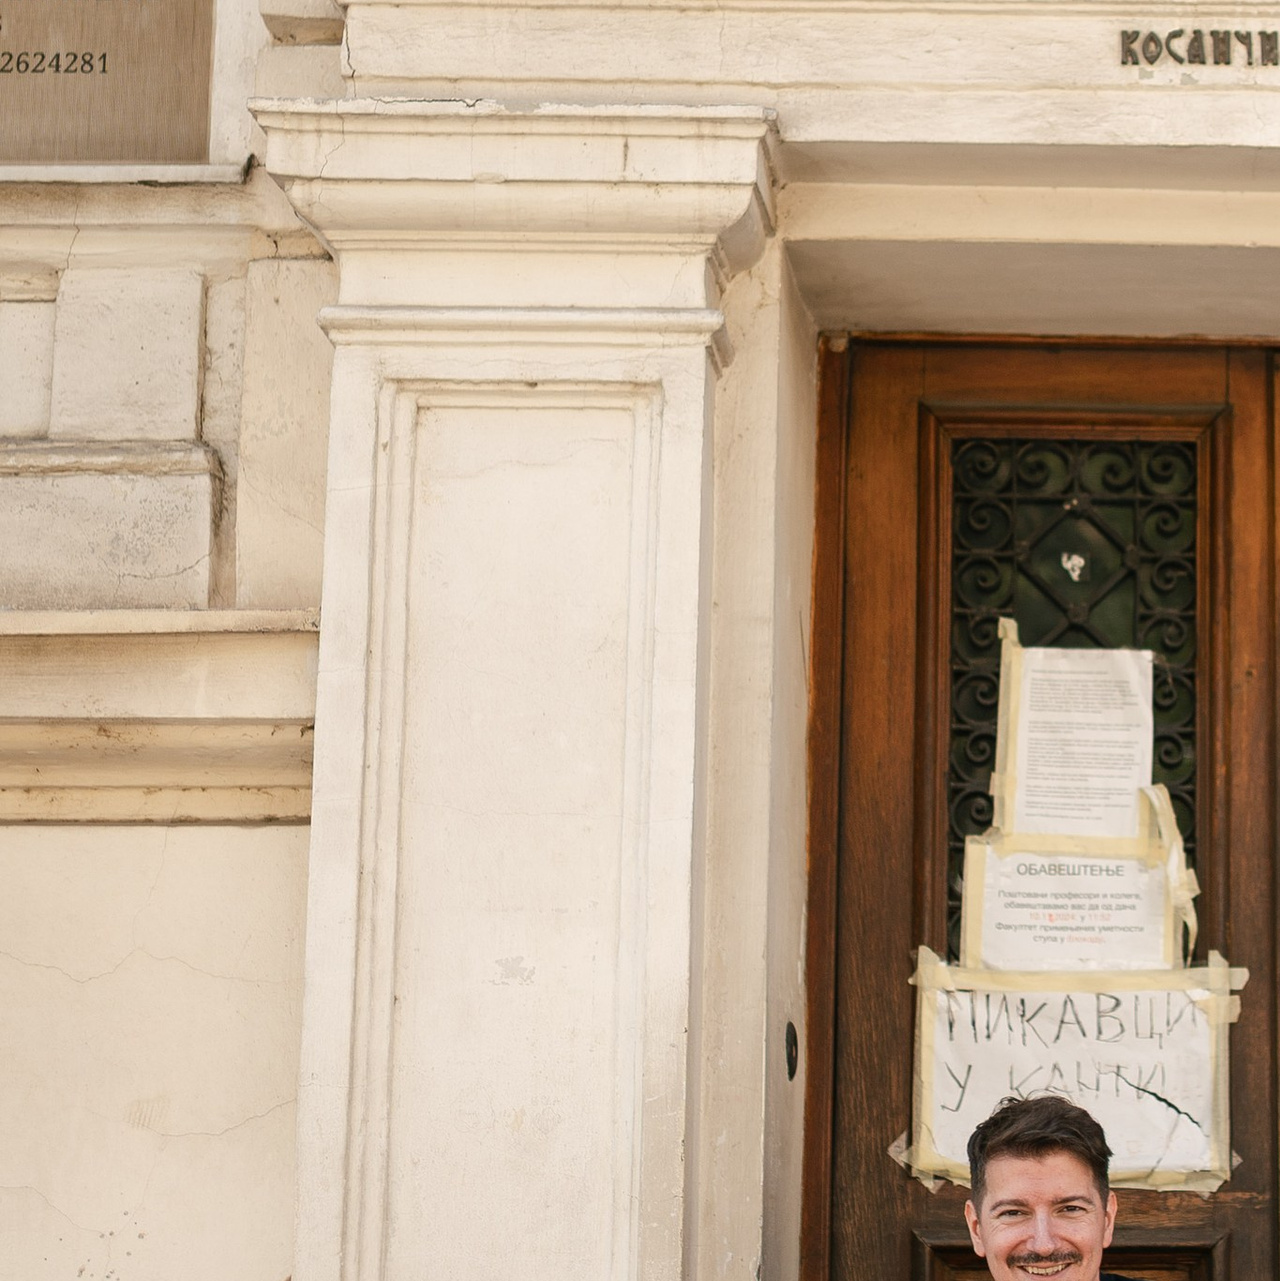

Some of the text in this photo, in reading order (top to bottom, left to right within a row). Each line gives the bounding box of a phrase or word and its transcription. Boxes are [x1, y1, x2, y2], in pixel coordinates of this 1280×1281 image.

[1016, 863, 1125, 877] ОБАВЕШТЕЊЕ
[1050, 890, 1100, 901] професори
[944, 988, 1198, 1050] ПИКАВЦИ
[940, 1061, 972, 1113] У
